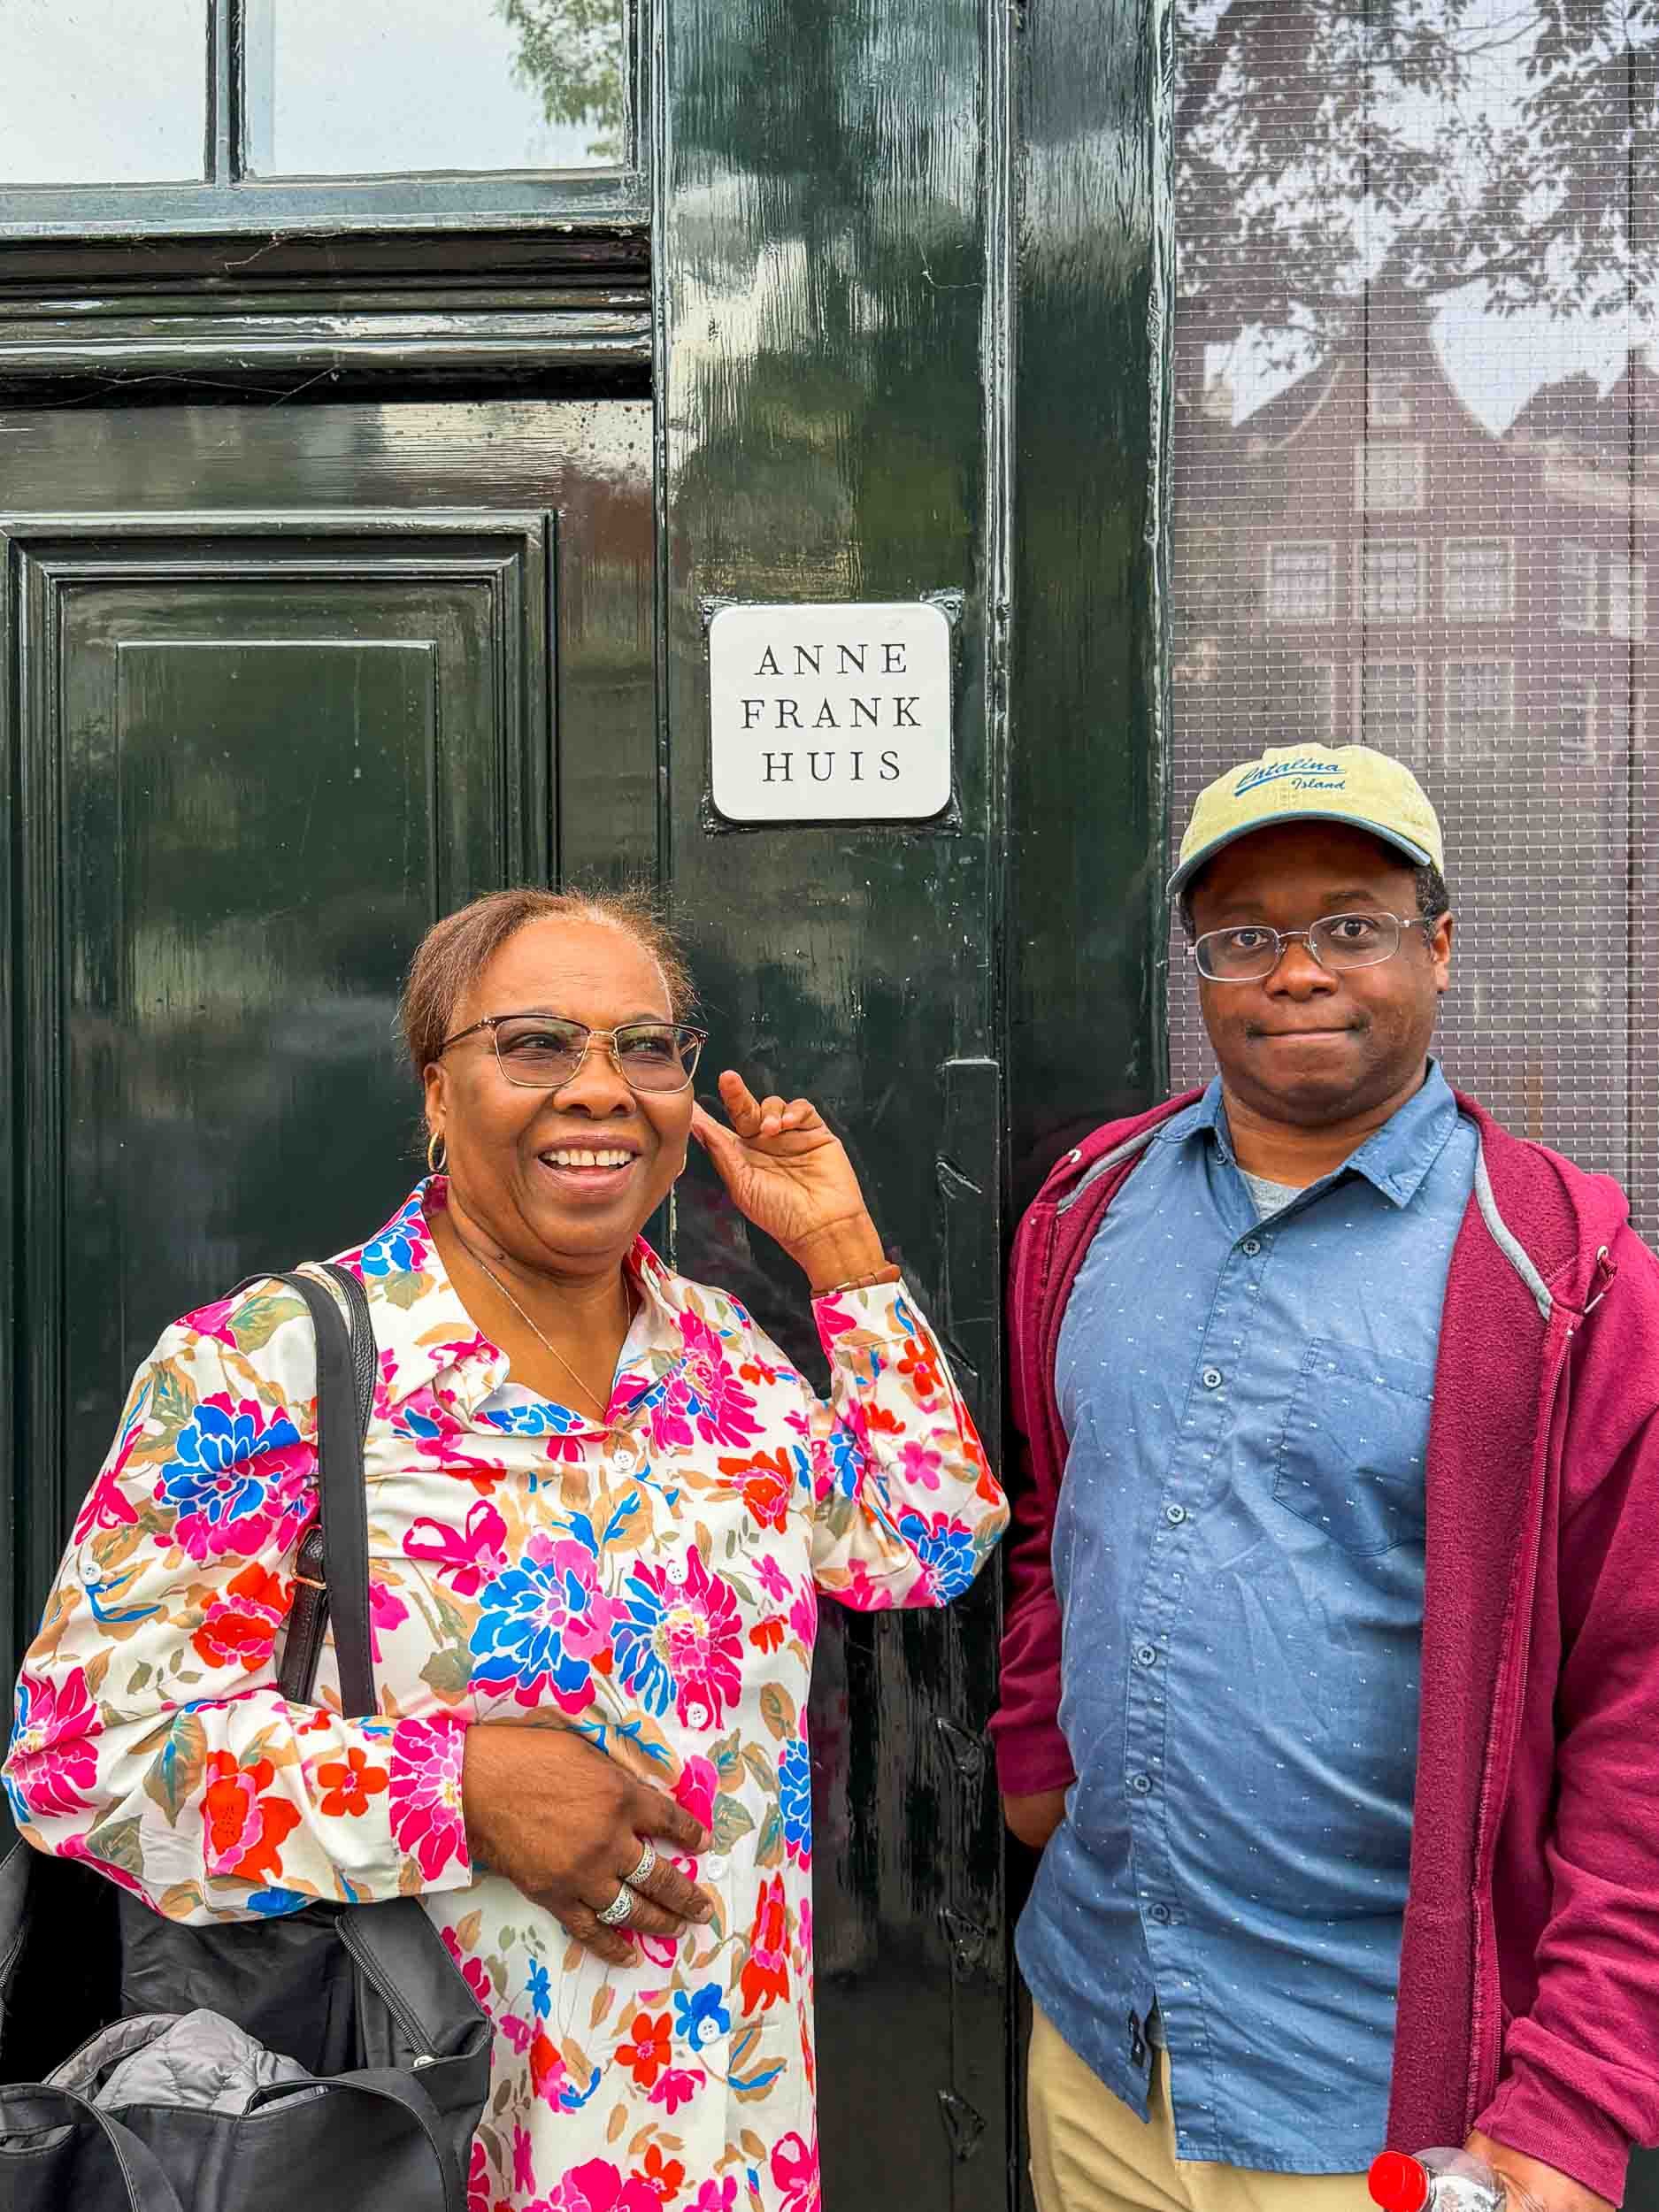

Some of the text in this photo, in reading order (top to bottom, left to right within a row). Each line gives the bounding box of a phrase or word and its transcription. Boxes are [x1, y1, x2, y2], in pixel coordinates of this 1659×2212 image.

[754, 643, 907, 676] ANNE
[740, 696, 922, 729] FRANK
[761, 750, 900, 782] HUIS
[1235, 757, 1340, 790] Catalina
[1291, 778, 1346, 790] Island
